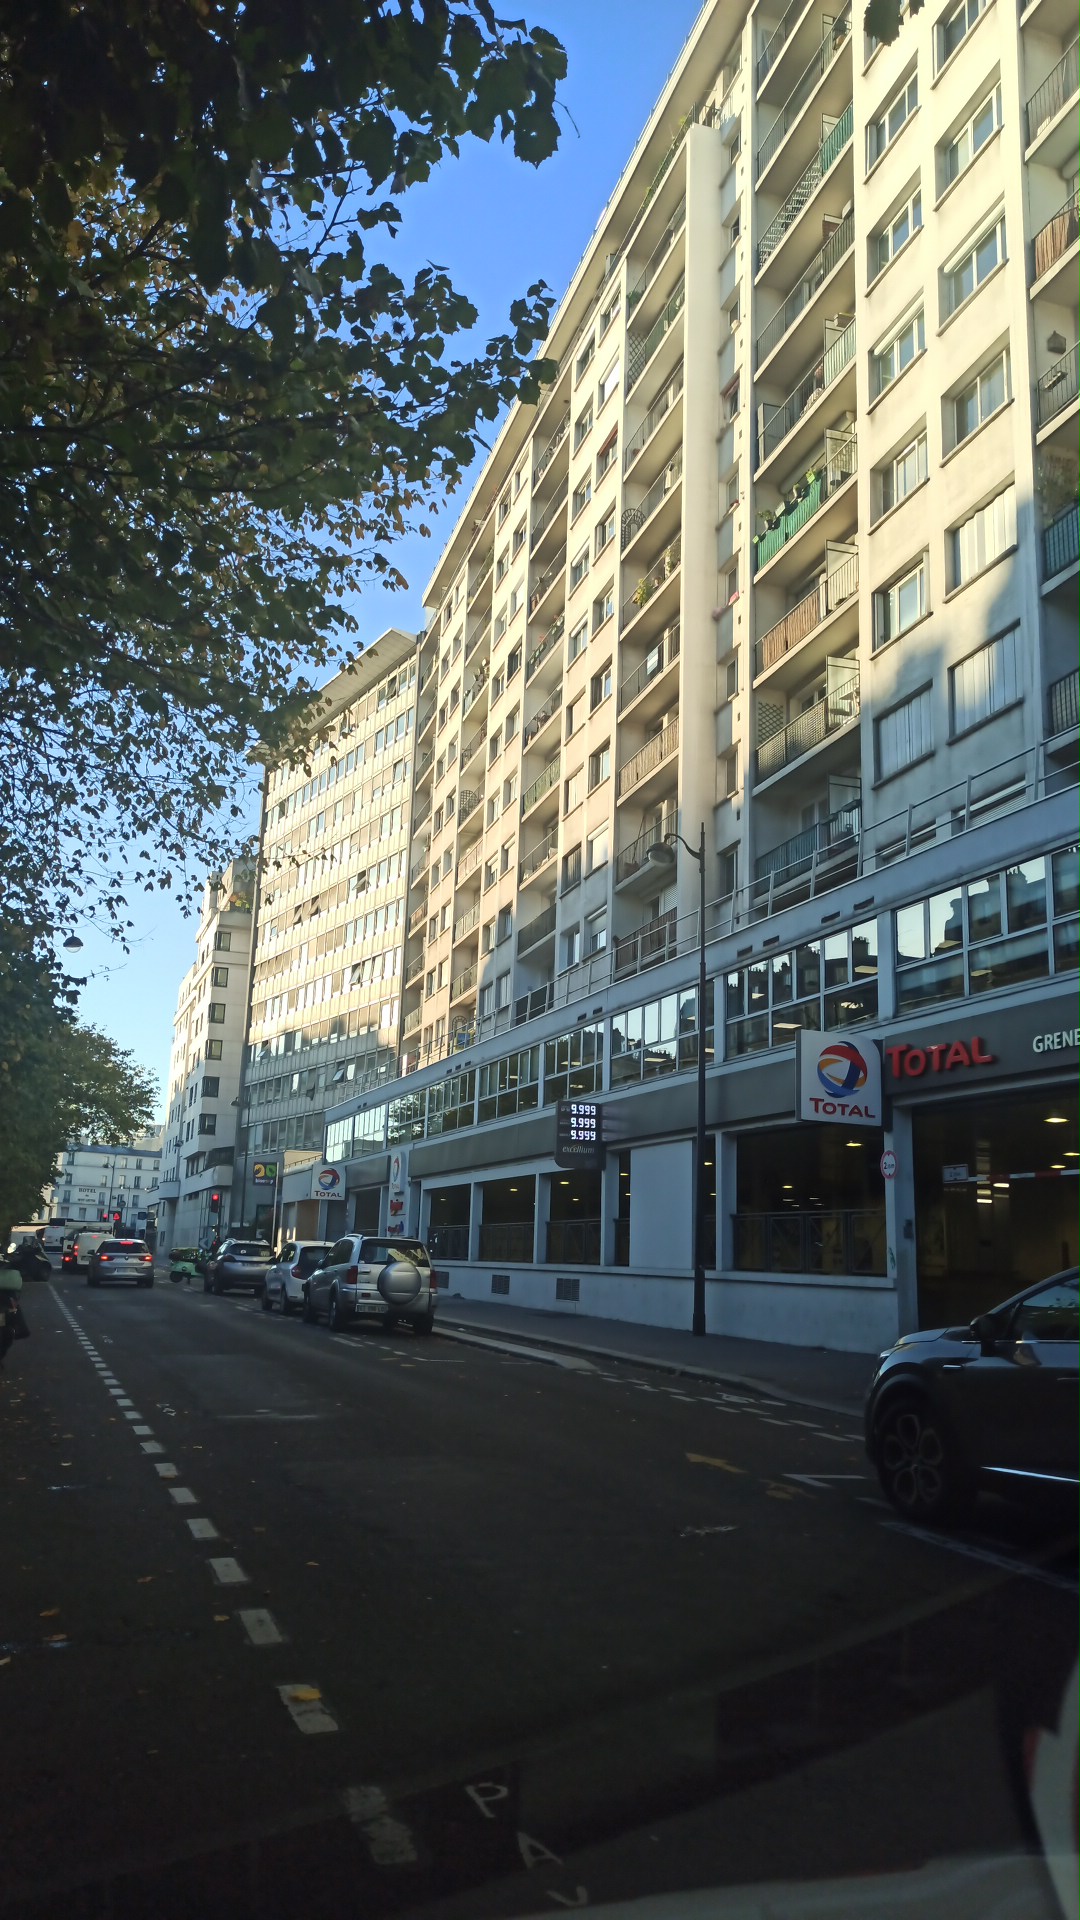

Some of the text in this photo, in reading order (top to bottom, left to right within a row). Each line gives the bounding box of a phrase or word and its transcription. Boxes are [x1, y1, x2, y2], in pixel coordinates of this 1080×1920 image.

[886, 1027, 1080, 1079] TOTAL GRENE
[570, 1103, 597, 1116] 9.999
[809, 1097, 876, 1119] TOTAL
[570, 1117, 596, 1129] 9.999
[570, 1130, 596, 1141] 9.999
[562, 1145, 595, 1154] excellium
[314, 1190, 342, 1198] TOTAL
